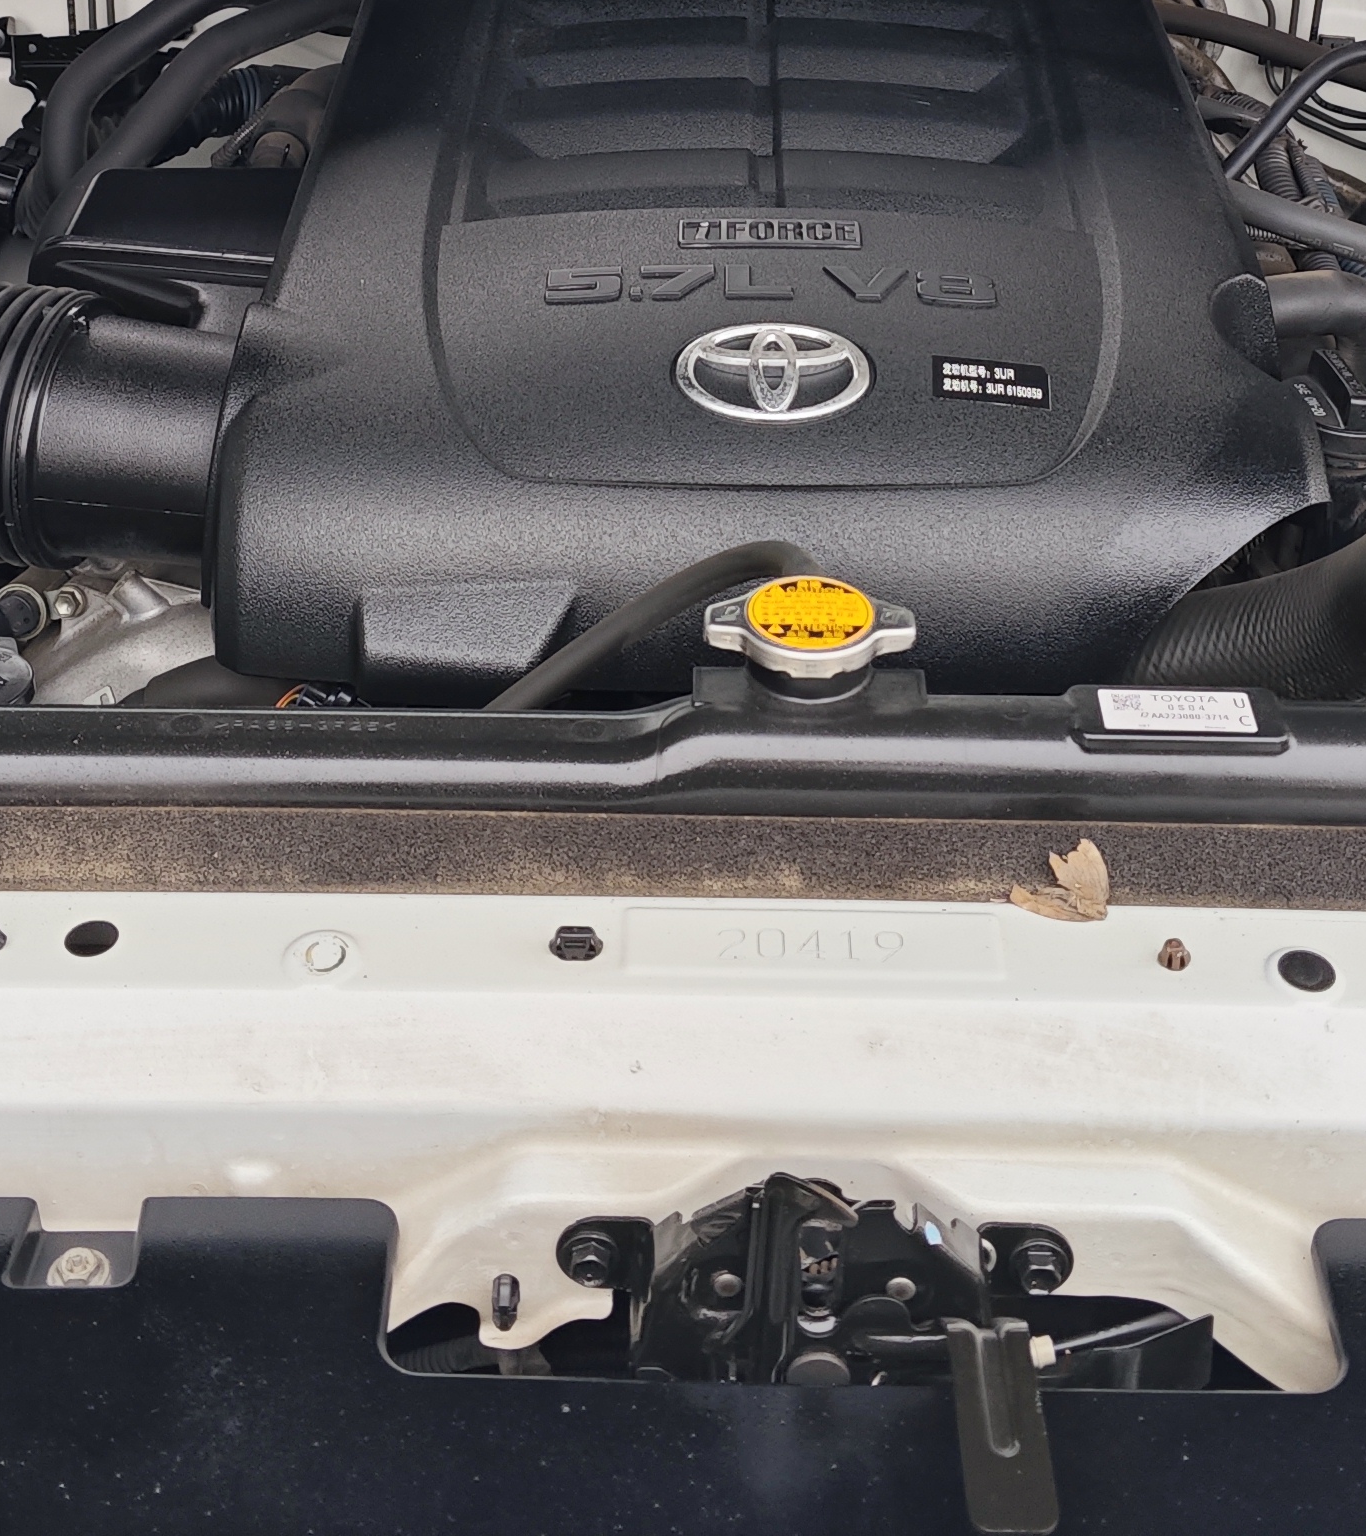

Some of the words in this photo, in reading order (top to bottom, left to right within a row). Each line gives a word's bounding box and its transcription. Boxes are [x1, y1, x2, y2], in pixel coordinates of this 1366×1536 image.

[544, 264, 795, 305] 5.7L
[822, 264, 999, 309] V8
[1150, 693, 1219, 705] TOYOTA
[716, 927, 905, 963] 20419
